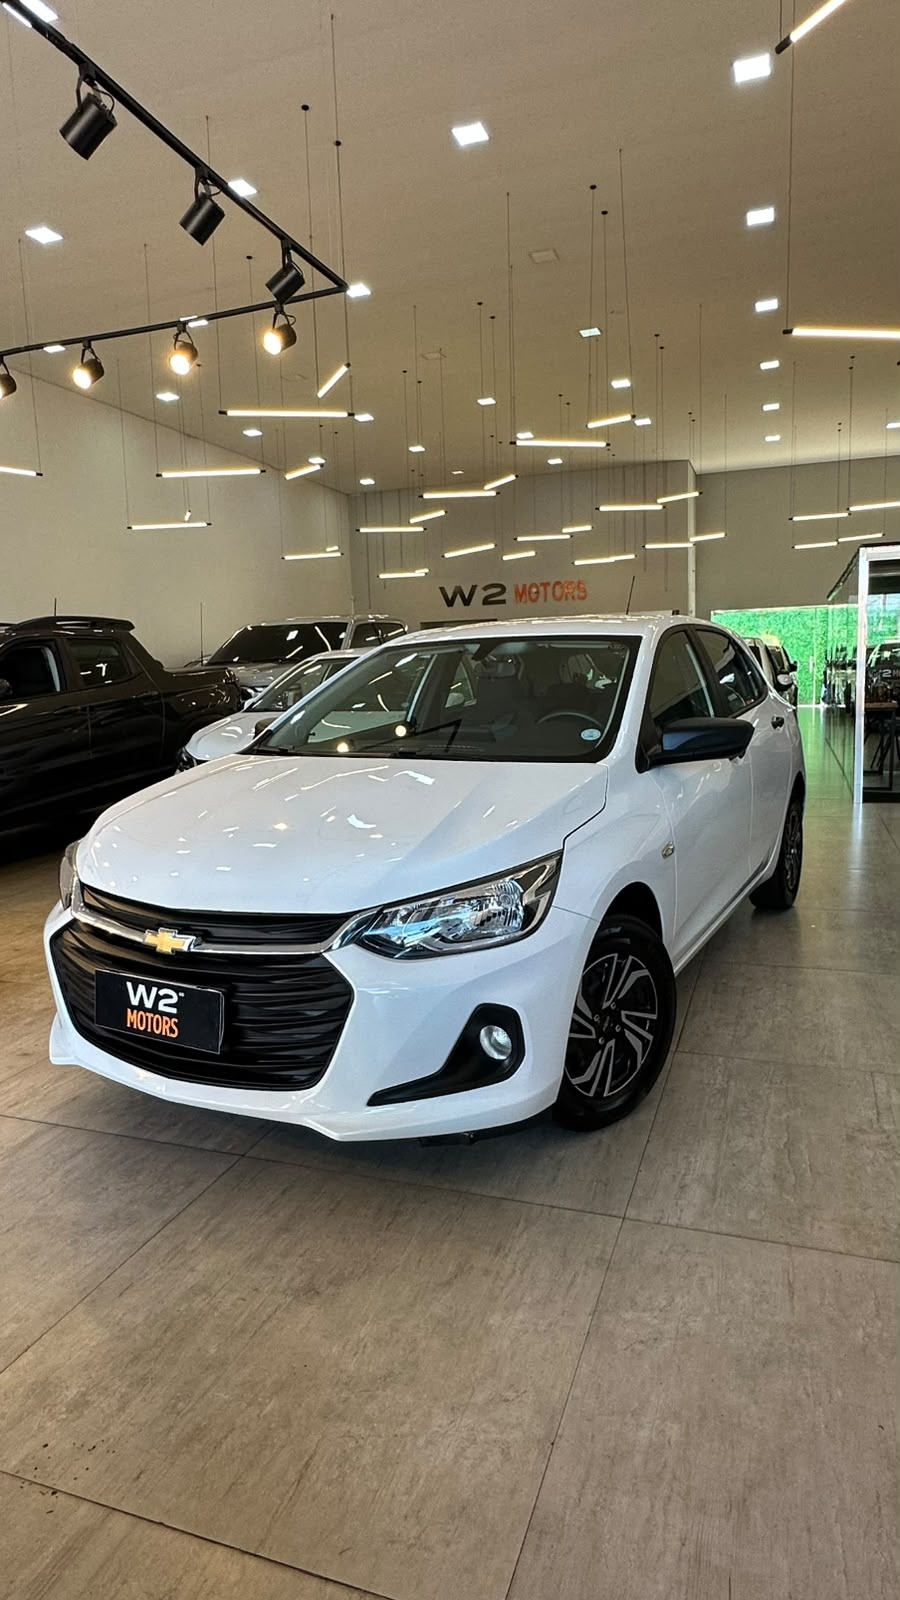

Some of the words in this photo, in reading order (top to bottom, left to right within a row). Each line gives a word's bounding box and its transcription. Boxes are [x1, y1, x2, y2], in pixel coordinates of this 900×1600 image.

[439, 583, 507, 607] W2
[514, 579, 588, 604] MOTORS
[126, 1008, 179, 1038] MOTORS
